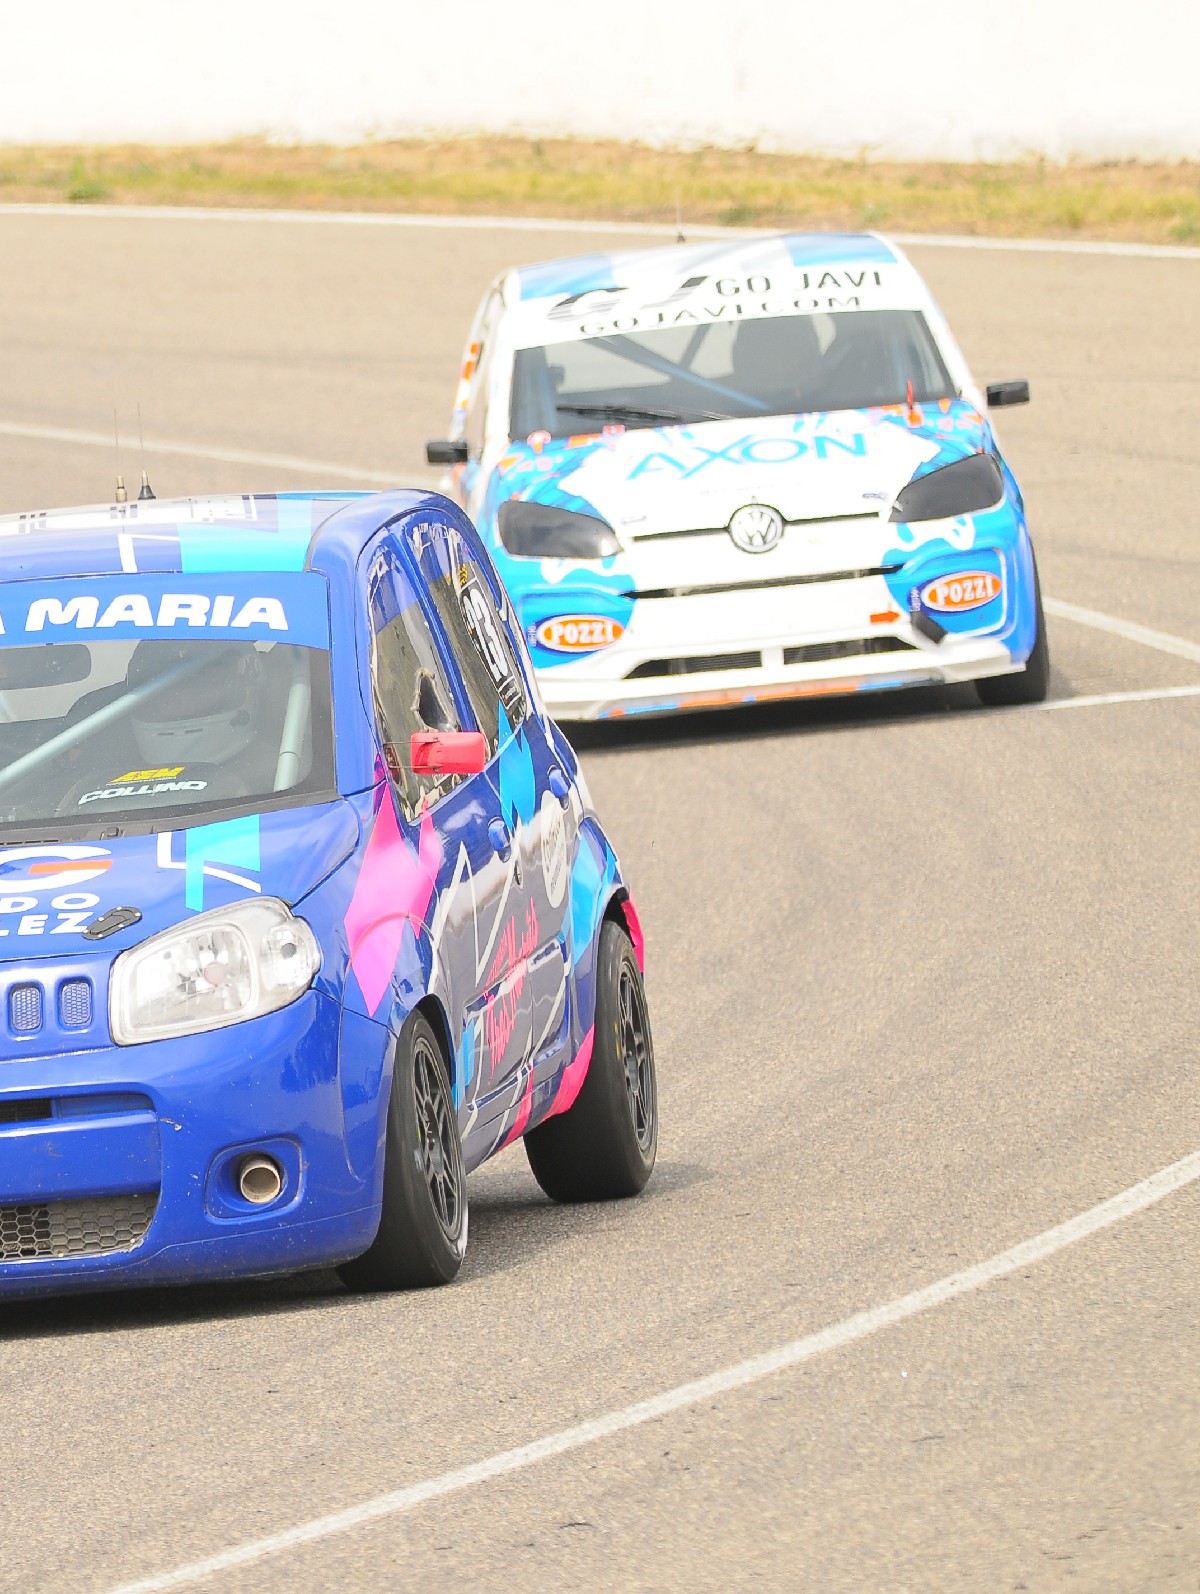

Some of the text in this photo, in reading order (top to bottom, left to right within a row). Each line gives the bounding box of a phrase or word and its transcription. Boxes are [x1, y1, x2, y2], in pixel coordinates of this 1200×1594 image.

[715, 270, 884, 298] GO JAVI
[627, 432, 869, 481] AXON
[936, 576, 995, 606] POZZI
[25, 594, 289, 632] MARIA
[552, 622, 615, 645] POZZI
